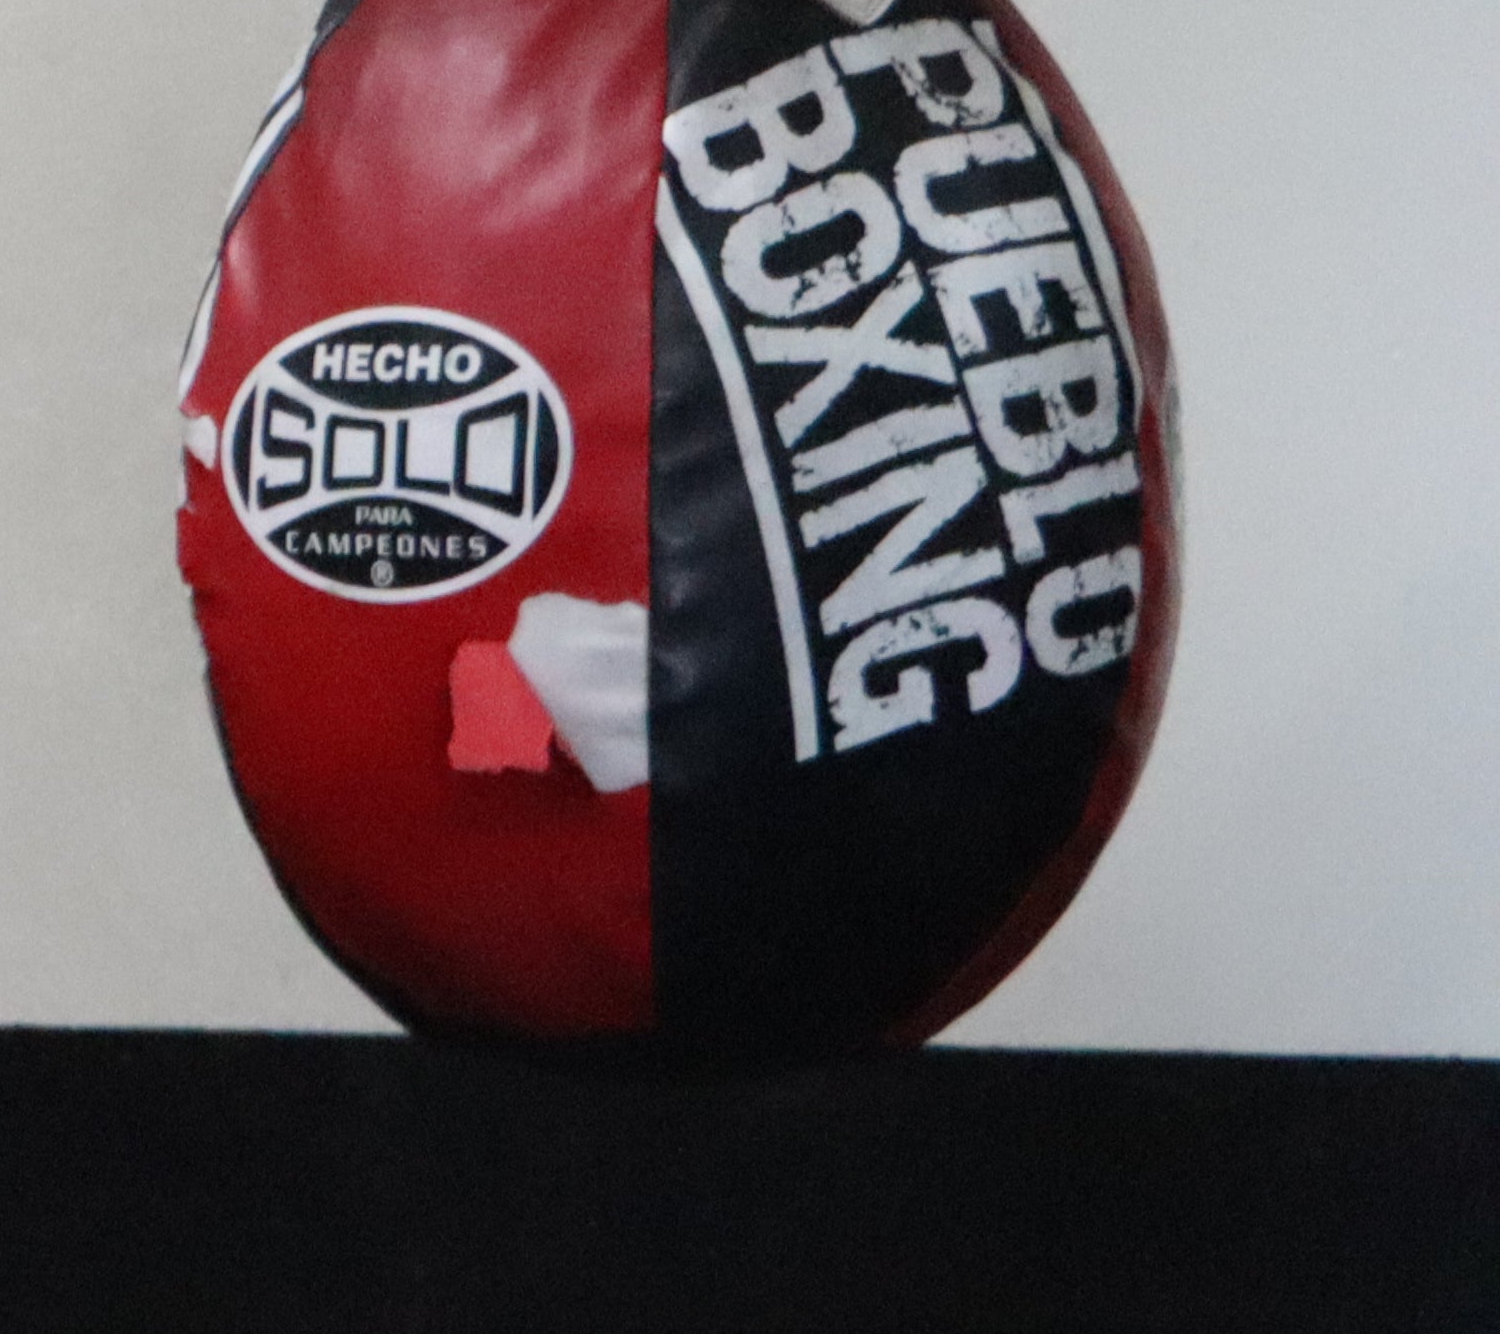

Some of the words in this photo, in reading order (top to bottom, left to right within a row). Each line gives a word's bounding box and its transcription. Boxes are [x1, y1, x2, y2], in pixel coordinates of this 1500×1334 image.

[312, 343, 482, 383] HECHO
[830, 15, 1142, 677] PUEBLO
[662, 47, 1024, 752] BOXING
[256, 387, 529, 518] SOLO
[285, 532, 488, 559] CAMPEONES
[355, 506, 413, 525] PARA
